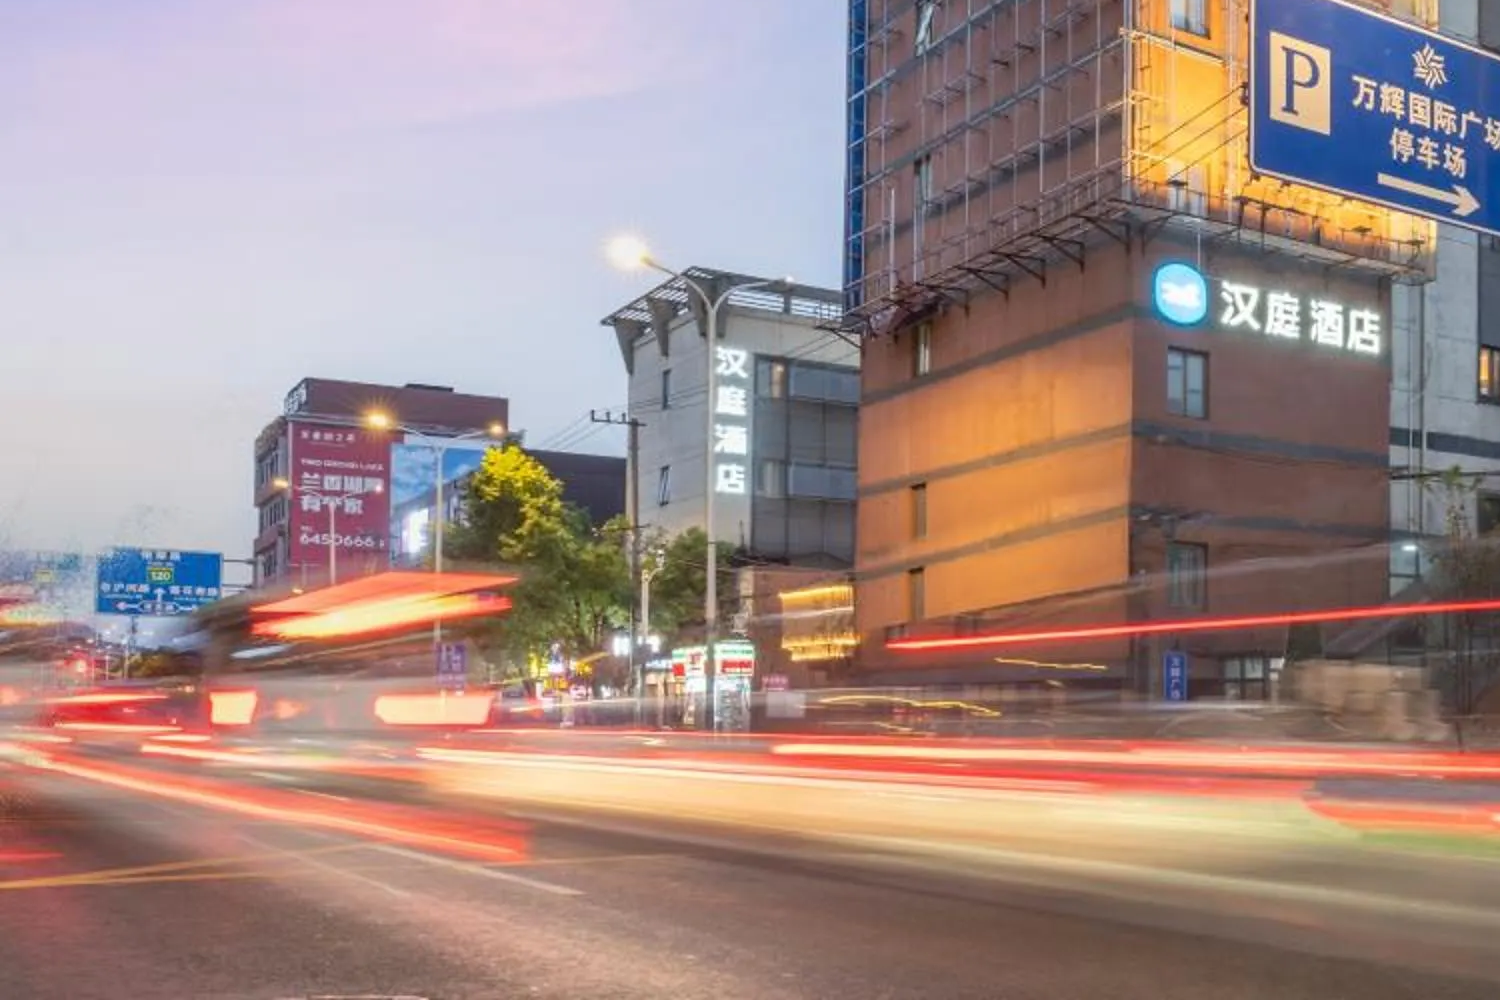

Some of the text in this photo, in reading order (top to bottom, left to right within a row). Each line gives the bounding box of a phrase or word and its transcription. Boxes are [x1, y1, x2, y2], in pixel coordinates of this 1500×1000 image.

[1281, 46, 1319, 116] P
[1389, 128, 1467, 179] 停车场
[1220, 281, 1382, 355] 汉庭酒店
[714, 346, 748, 495] 汉庭酒店
